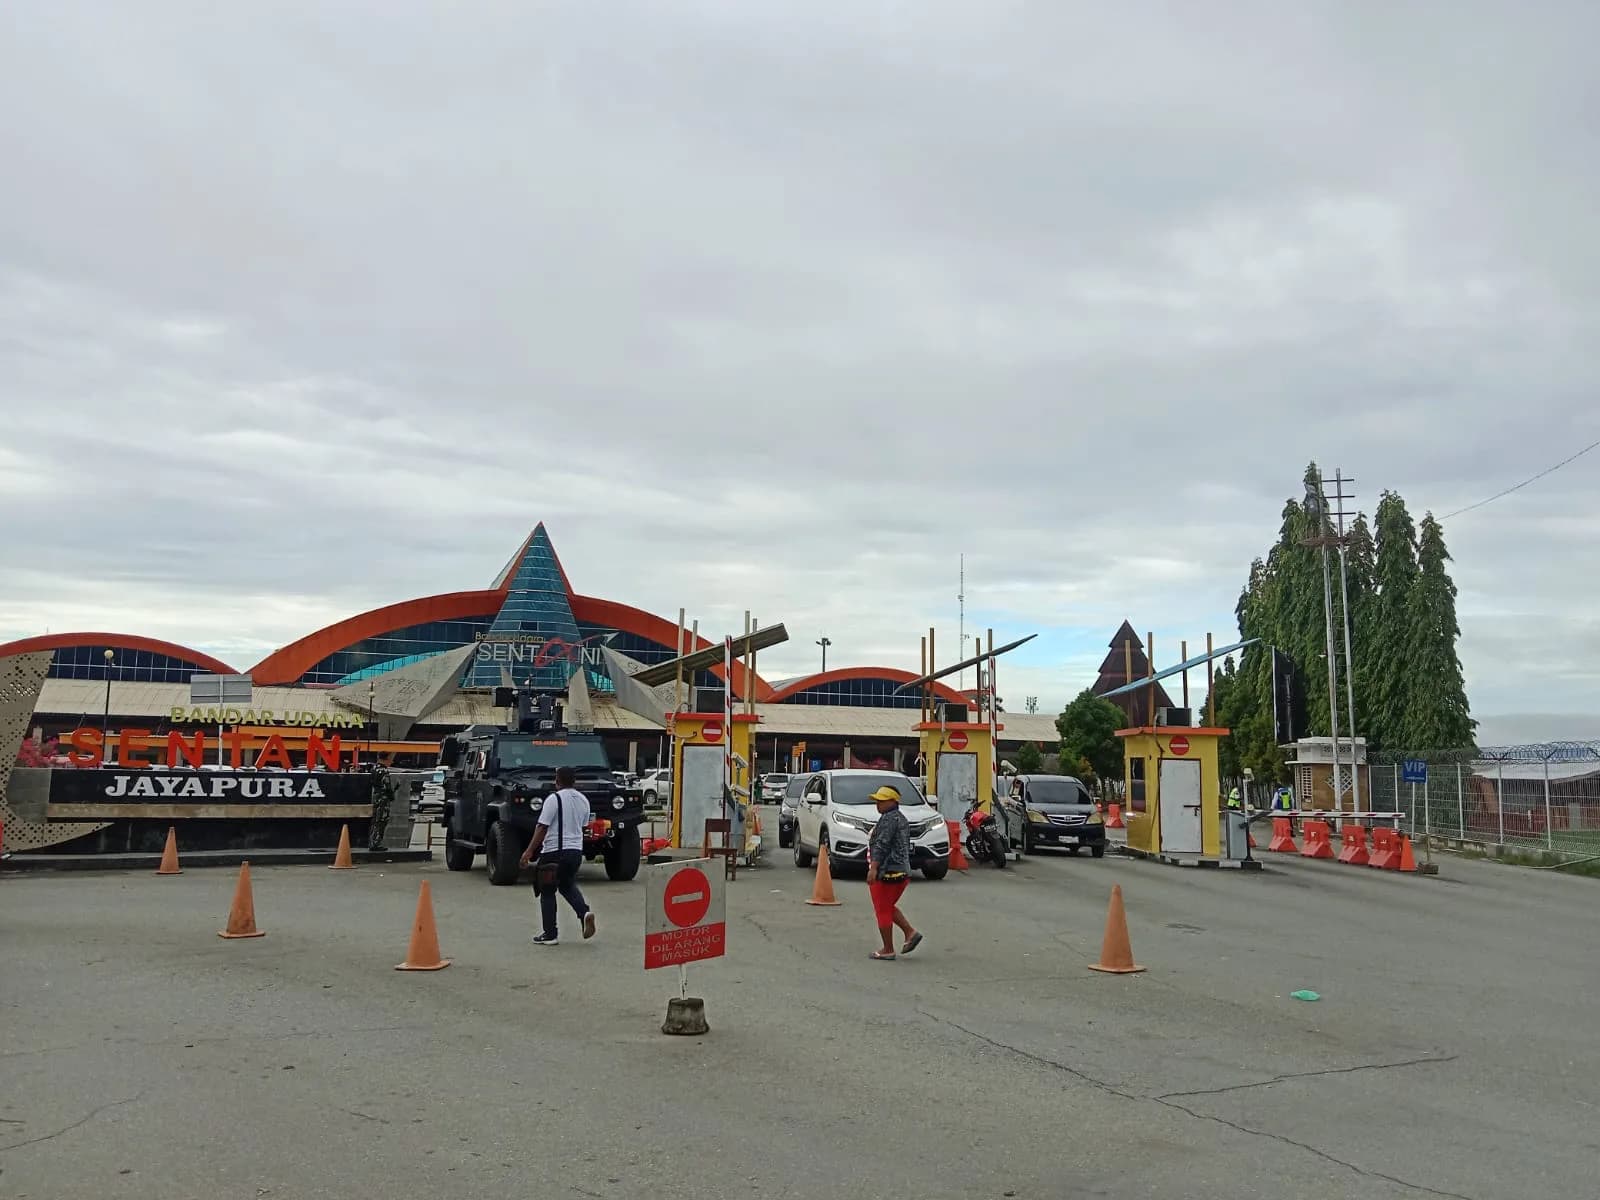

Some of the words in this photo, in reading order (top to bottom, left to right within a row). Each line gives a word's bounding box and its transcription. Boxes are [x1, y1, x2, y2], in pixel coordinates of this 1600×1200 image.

[170, 707, 274, 726] BANDAR
[283, 710, 365, 729] UDARA
[68, 728, 341, 771] SENTAN
[1404, 761, 1425, 772] VIP
[105, 776, 326, 798] JAYAPURA
[662, 926, 710, 941] MOTOR
[652, 934, 721, 953] DILARANG
[662, 945, 710, 962] MASUK
